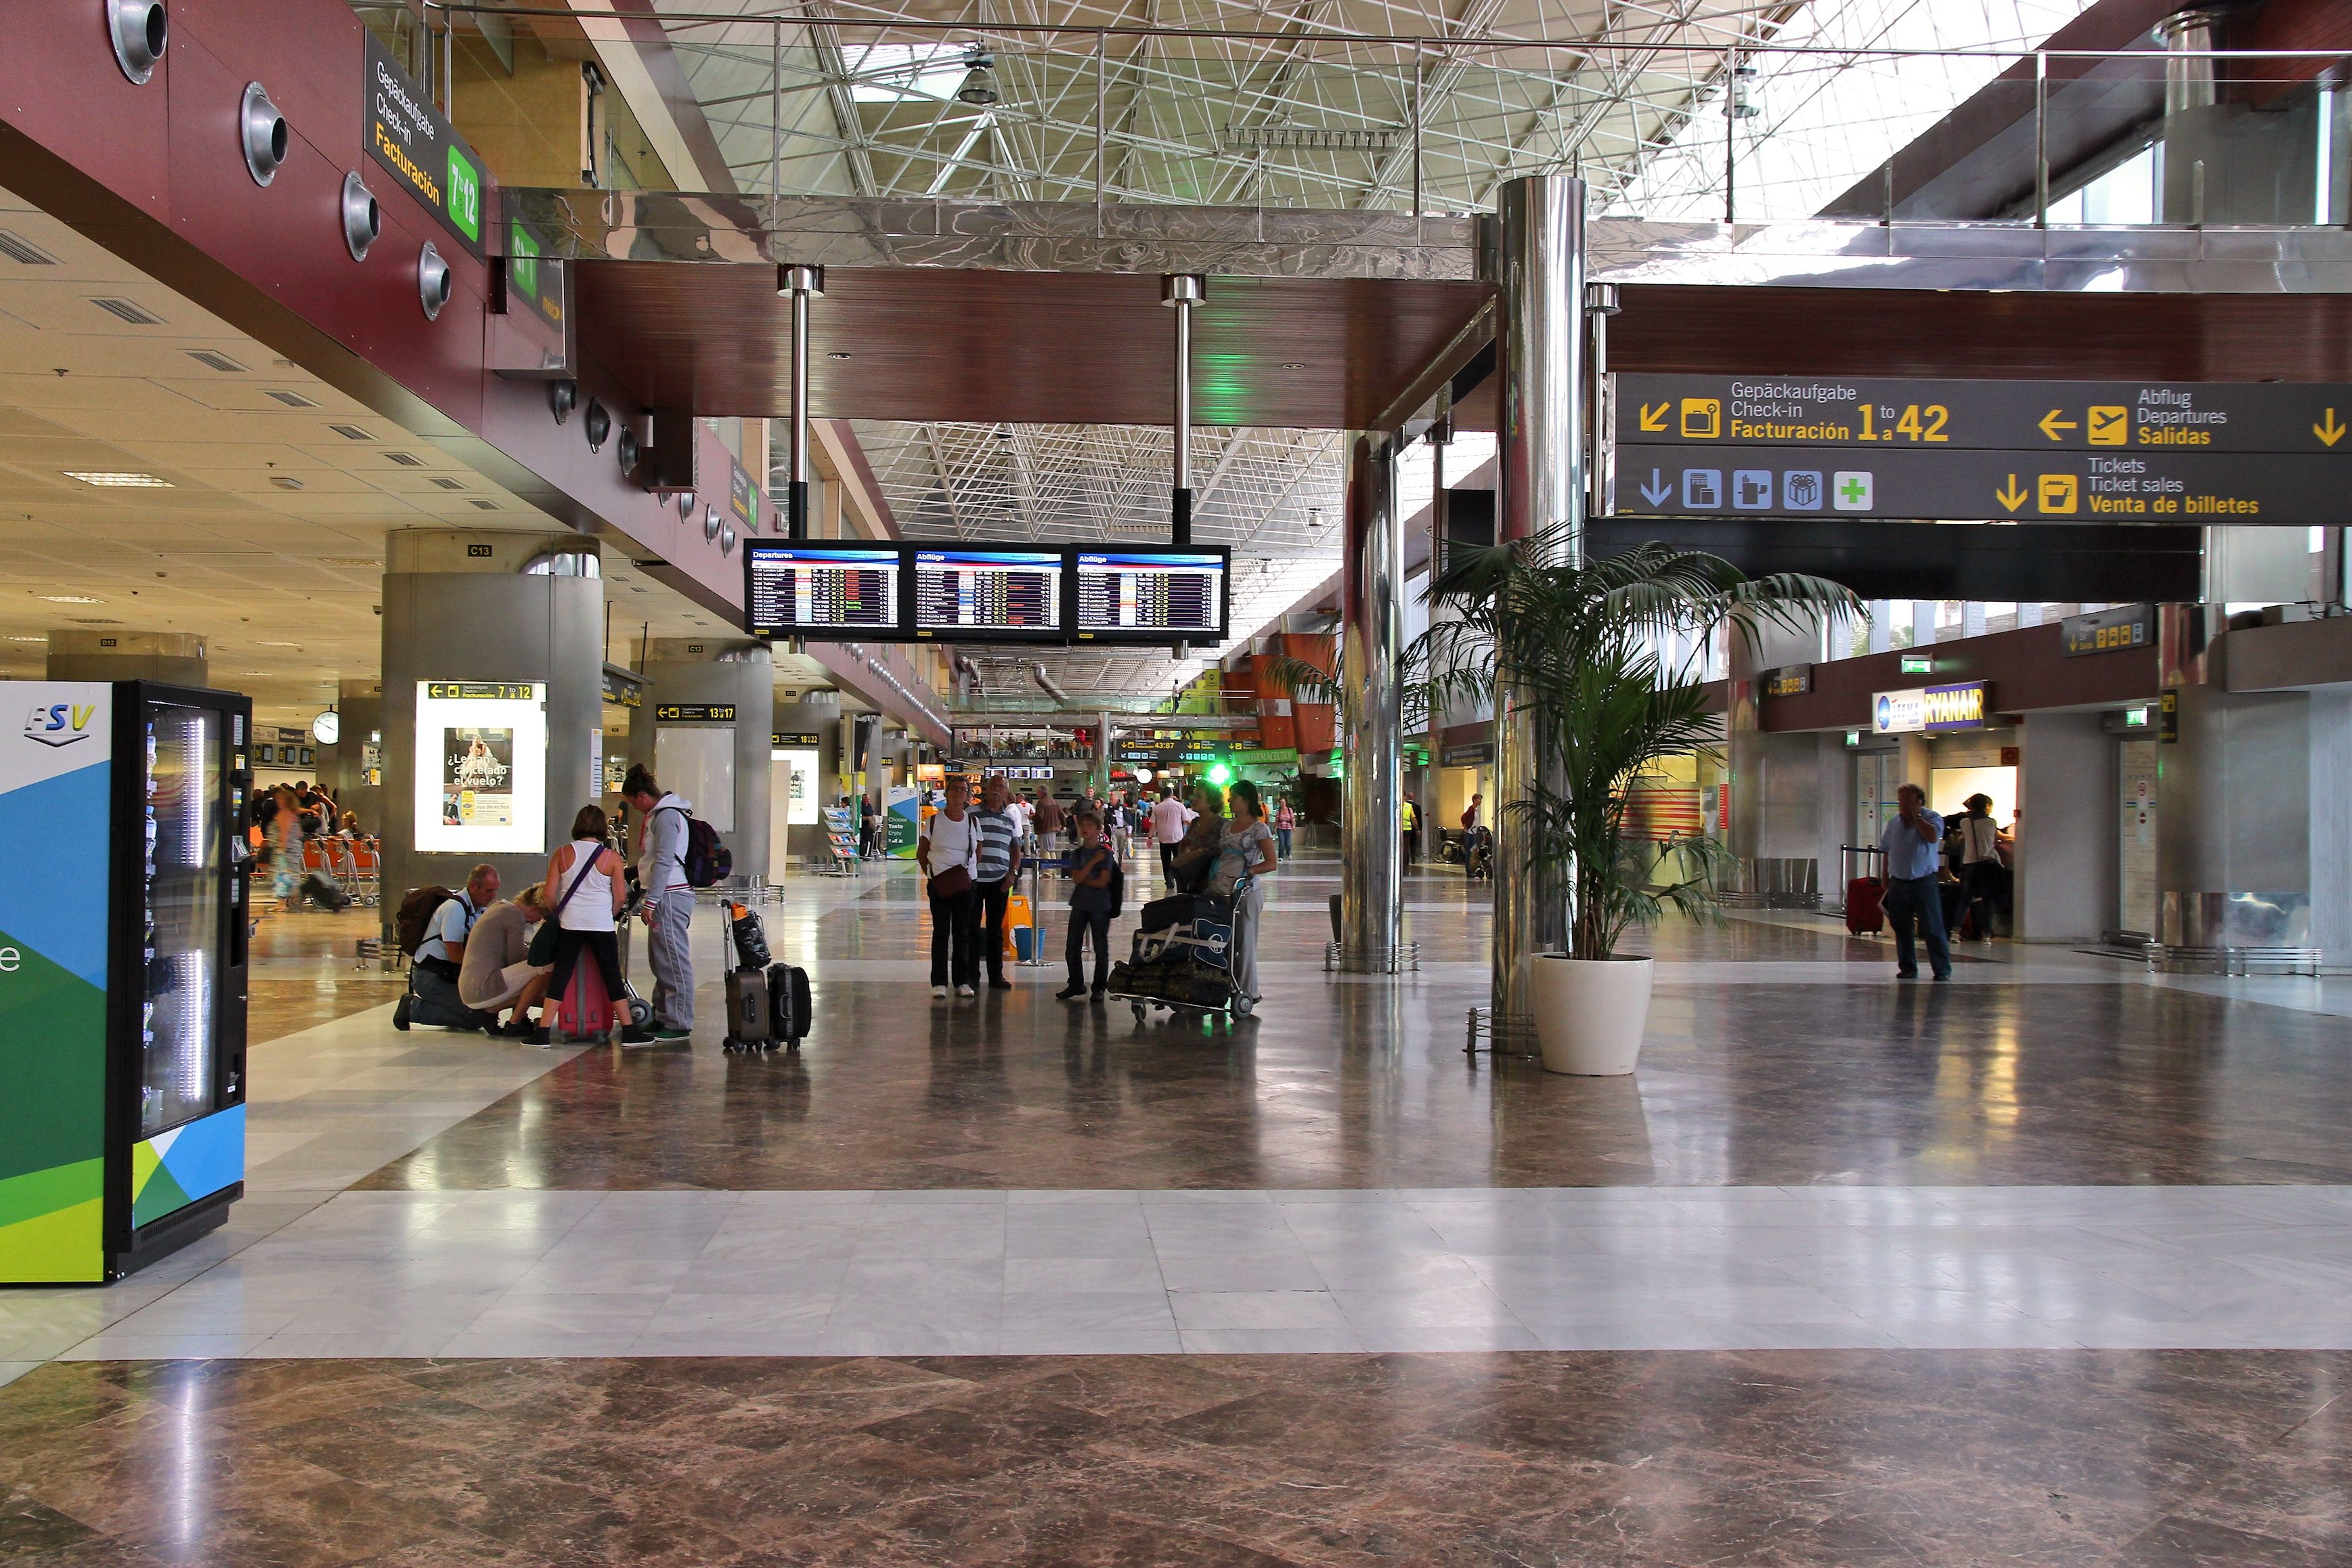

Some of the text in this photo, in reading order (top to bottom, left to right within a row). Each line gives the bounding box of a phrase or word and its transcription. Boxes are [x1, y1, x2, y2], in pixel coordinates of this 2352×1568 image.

[377, 61, 435, 140] Gepäckaufgabe
[376, 92, 411, 146] Check-in
[376, 121, 440, 206] Facturación
[452, 162, 458, 206] 7
[464, 177, 475, 225] 12
[1731, 381, 1856, 403] Gepäckaufgabe
[2138, 389, 2192, 408] Abflug
[1731, 401, 1802, 418] Check-in
[2138, 408, 2227, 427] Departures
[1731, 419, 1849, 441] Facturación
[1858, 404, 1948, 441] 1 to 42
[1883, 428, 1892, 441] a
[2138, 427, 2211, 445] Salidas
[2089, 458, 2146, 474] Tickets
[2089, 477, 2183, 493] Ticket sales
[2089, 496, 2259, 515] Venta de billetes
[471, 546, 489, 555] C13
[753, 551, 793, 559] Departures
[1079, 556, 1107, 564] Abflüge
[498, 686, 505, 698] 7
[519, 686, 530, 699] 12
[710, 708, 718, 718] 13
[724, 708, 733, 718] 17
[1925, 688, 1983, 724] RYANAIR
[448, 753, 467, 766] ¿Le
[454, 766, 507, 775] cancelado
[454, 775, 503, 786] el vuelo?
